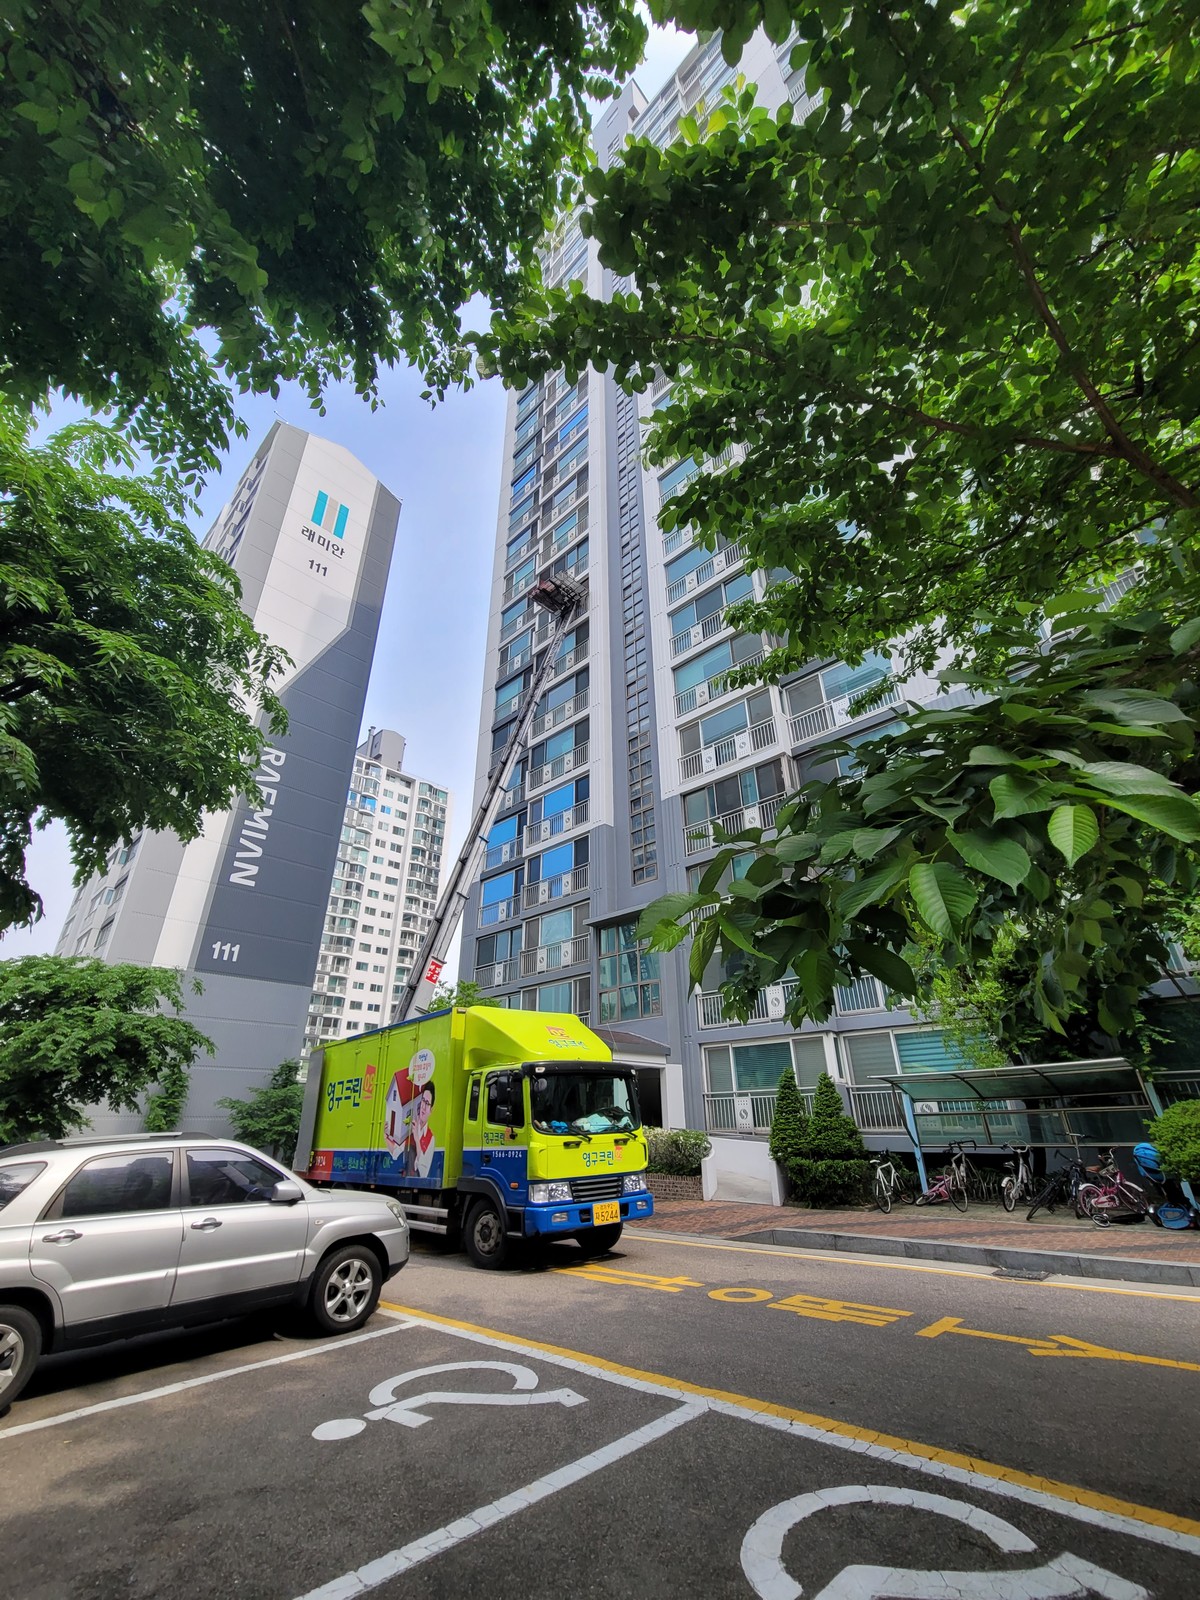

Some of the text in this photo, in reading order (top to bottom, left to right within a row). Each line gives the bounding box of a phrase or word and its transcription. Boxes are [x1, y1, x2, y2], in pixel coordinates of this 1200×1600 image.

[301, 525, 345, 559] 래미안
[308, 559, 328, 577] 111
[229, 746, 286, 887] RAEMIAN
[212, 941, 240, 962] 111
[548, 1039, 590, 1050] 영구크린
[327, 1077, 363, 1112] 영구크린
[483, 1132, 505, 1146] 영구크린
[492, 1150, 522, 1158] 1566-0924
[582, 1151, 614, 1167] 영구크린
